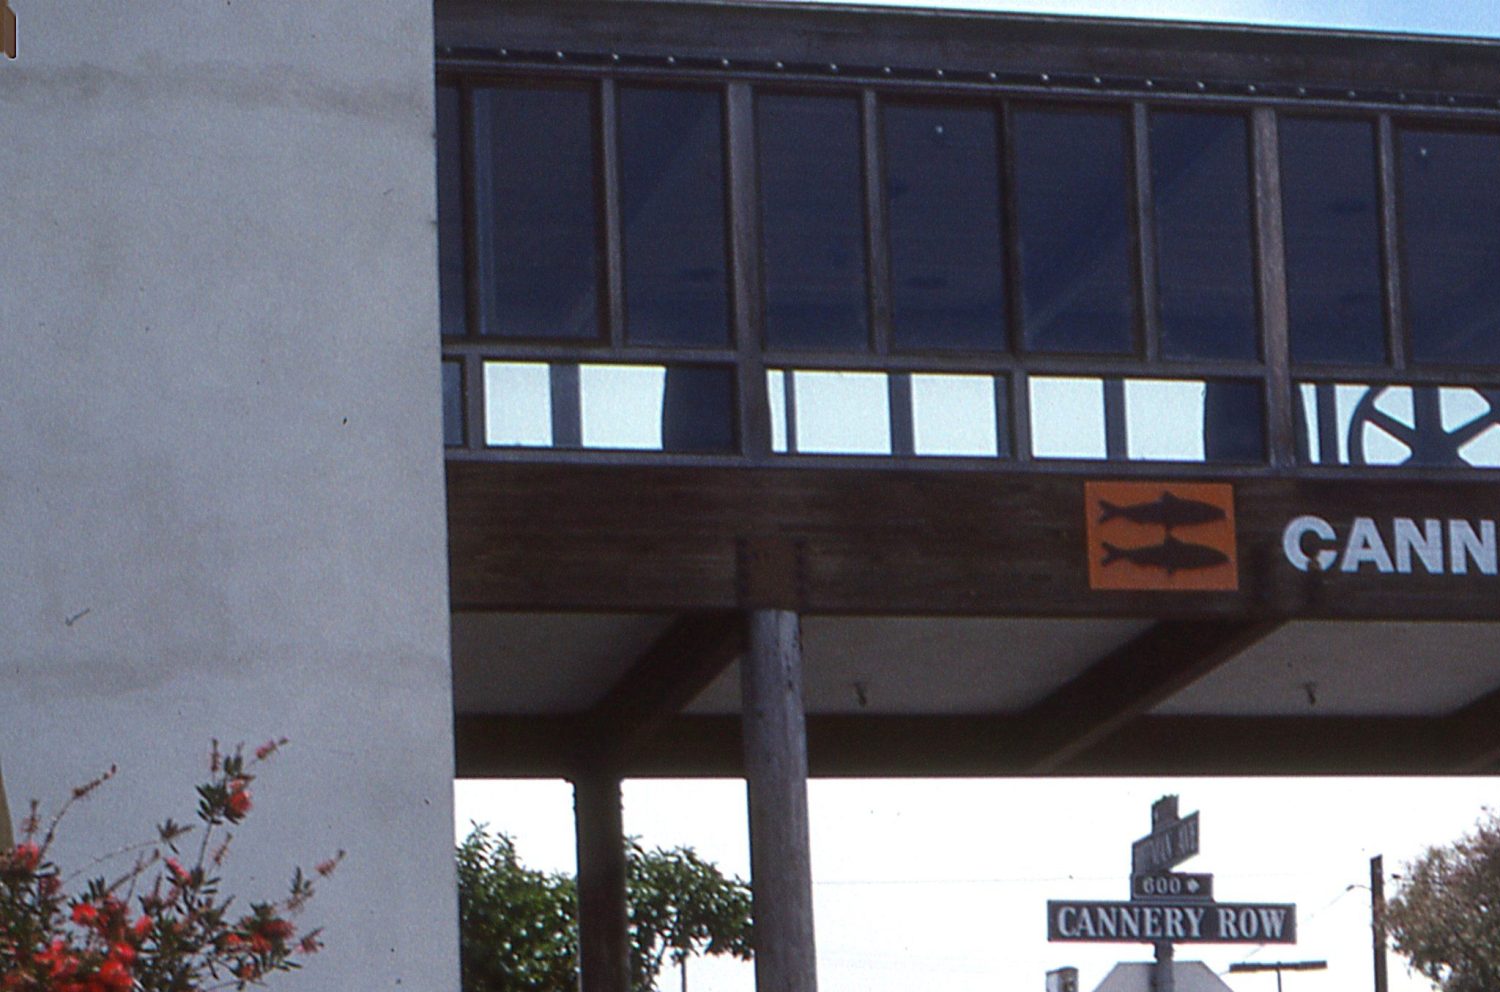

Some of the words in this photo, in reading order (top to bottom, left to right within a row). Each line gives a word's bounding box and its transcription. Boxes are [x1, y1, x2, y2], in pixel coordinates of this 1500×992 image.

[1143, 877, 1181, 895] 600
[1057, 905, 1205, 938] CANNERY
[1218, 908, 1287, 940] ROW
